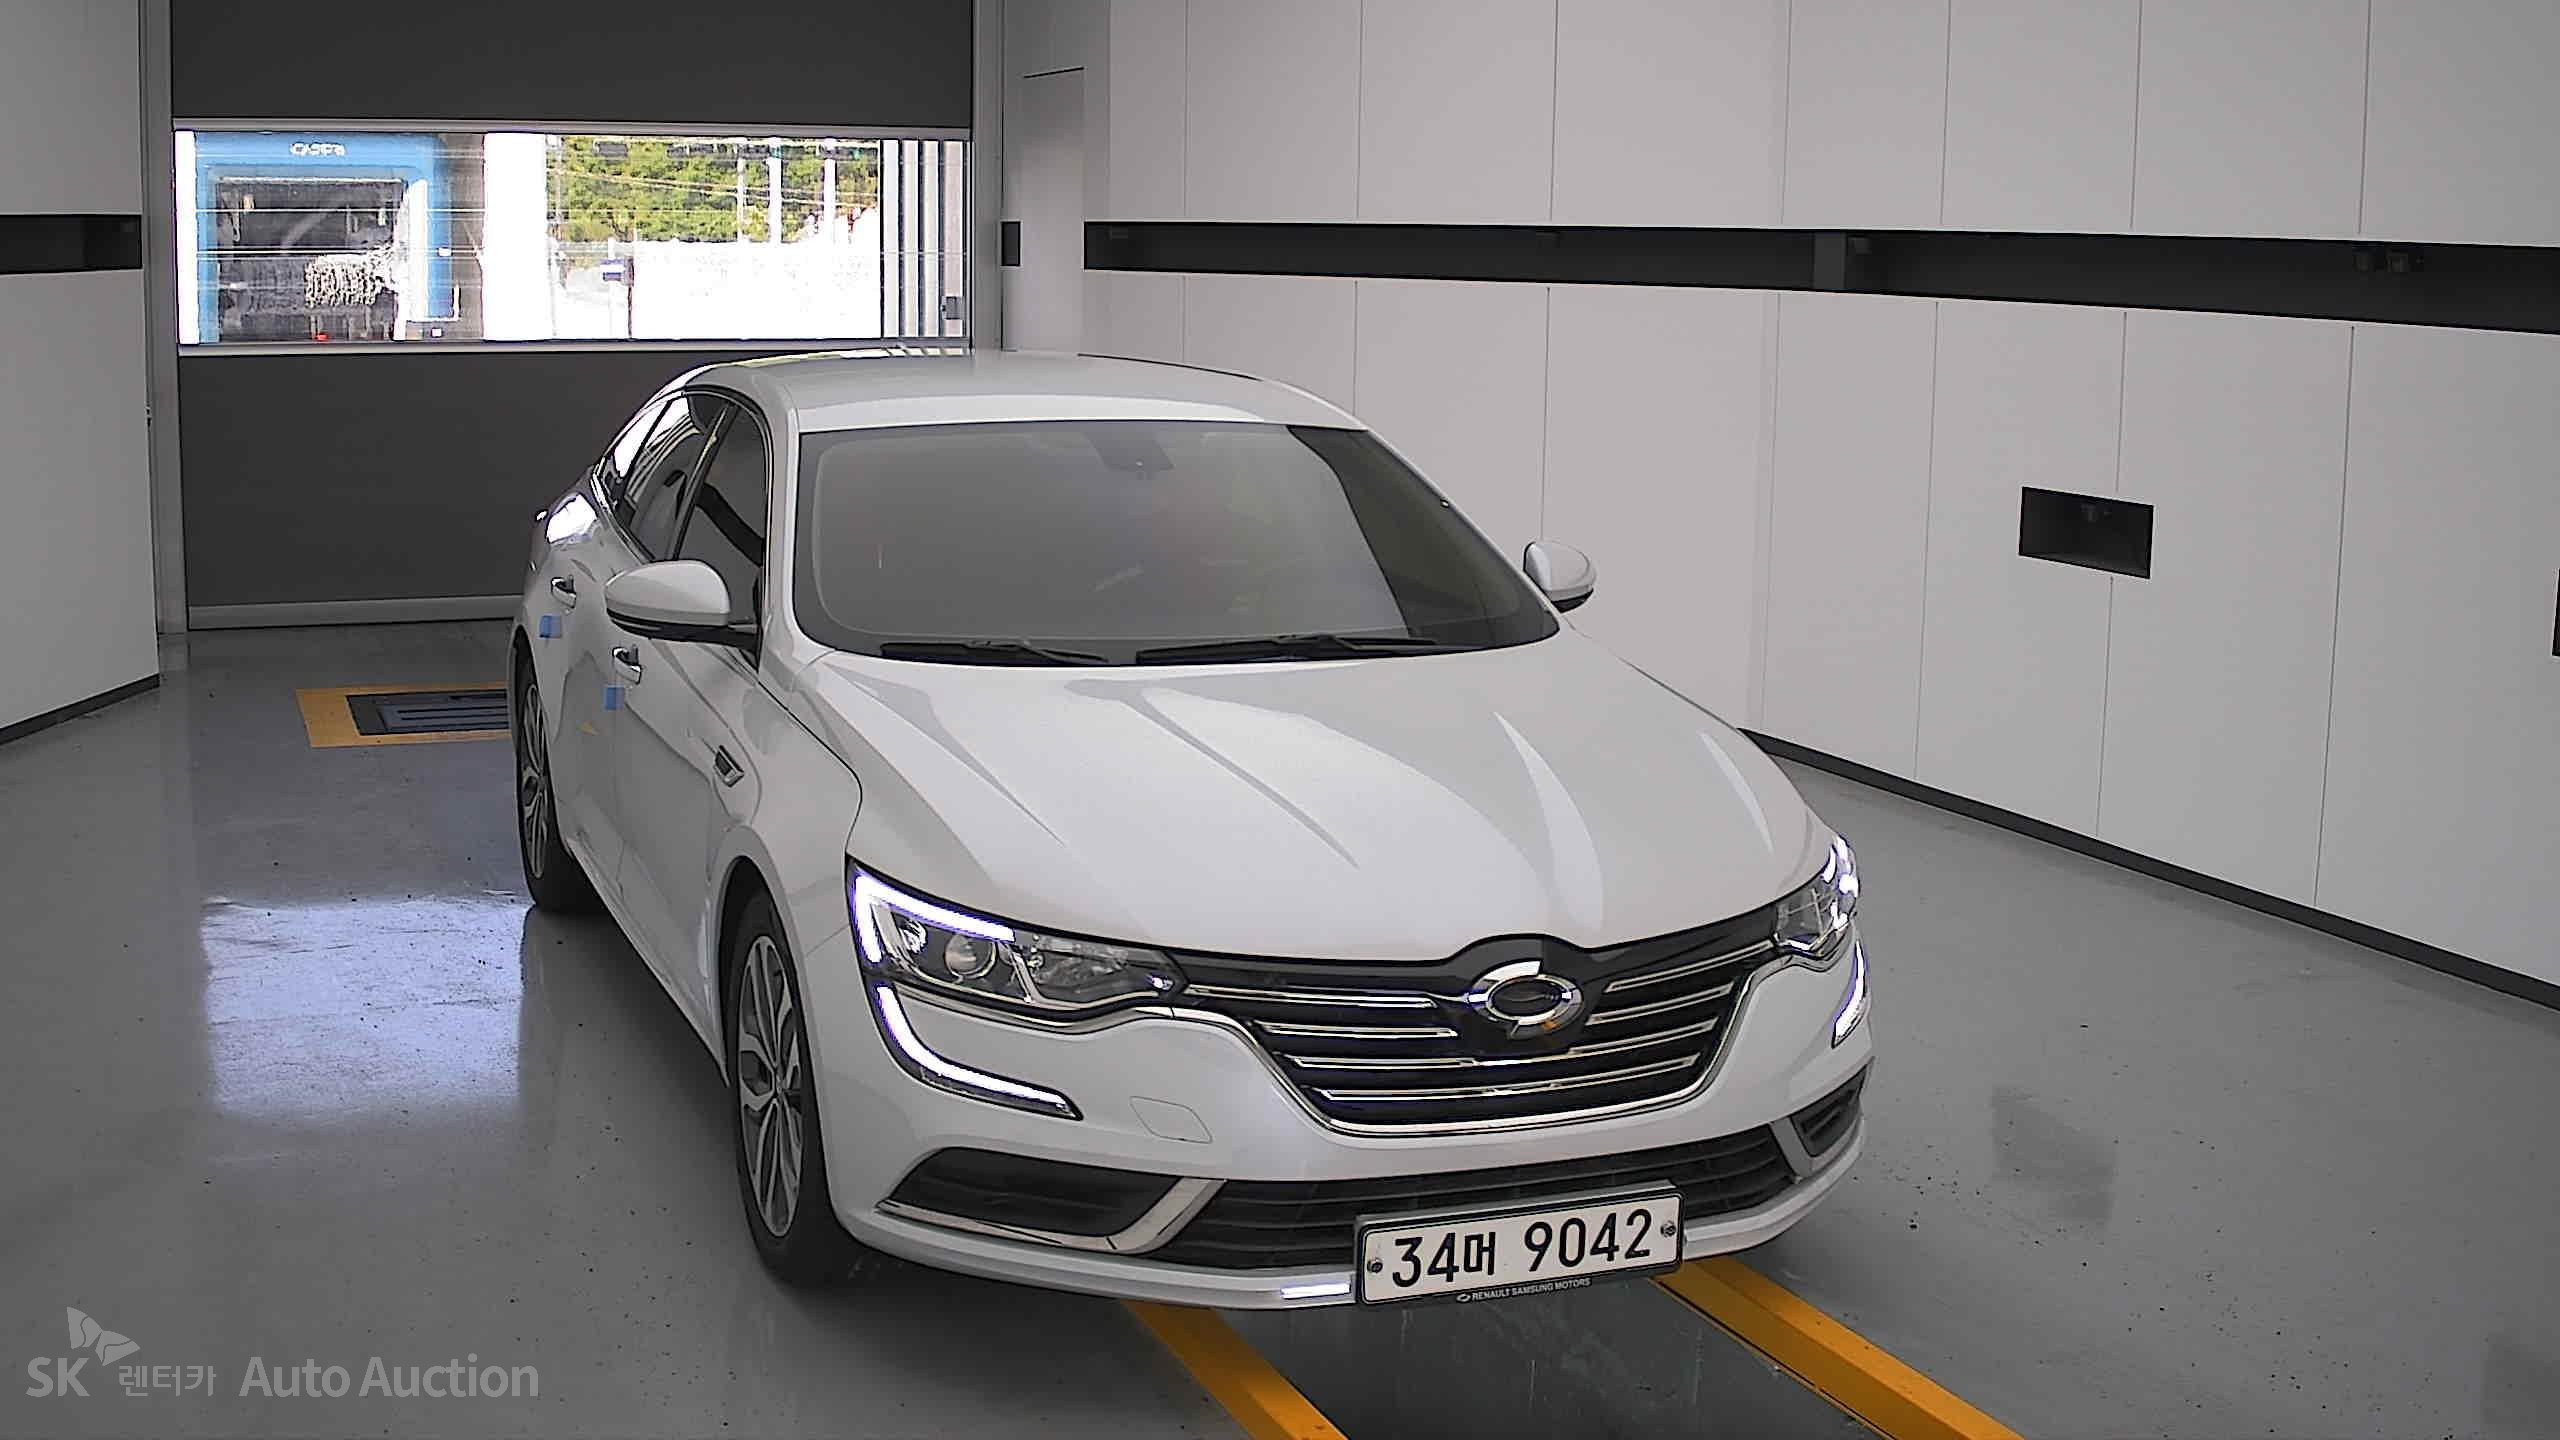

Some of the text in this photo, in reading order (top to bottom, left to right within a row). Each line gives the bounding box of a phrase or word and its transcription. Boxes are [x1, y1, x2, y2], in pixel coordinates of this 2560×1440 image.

[1392, 1208, 1653, 1288] 34머 9042
[1471, 1277, 1591, 1301] RENAULT SAMSUNG MOTORS
